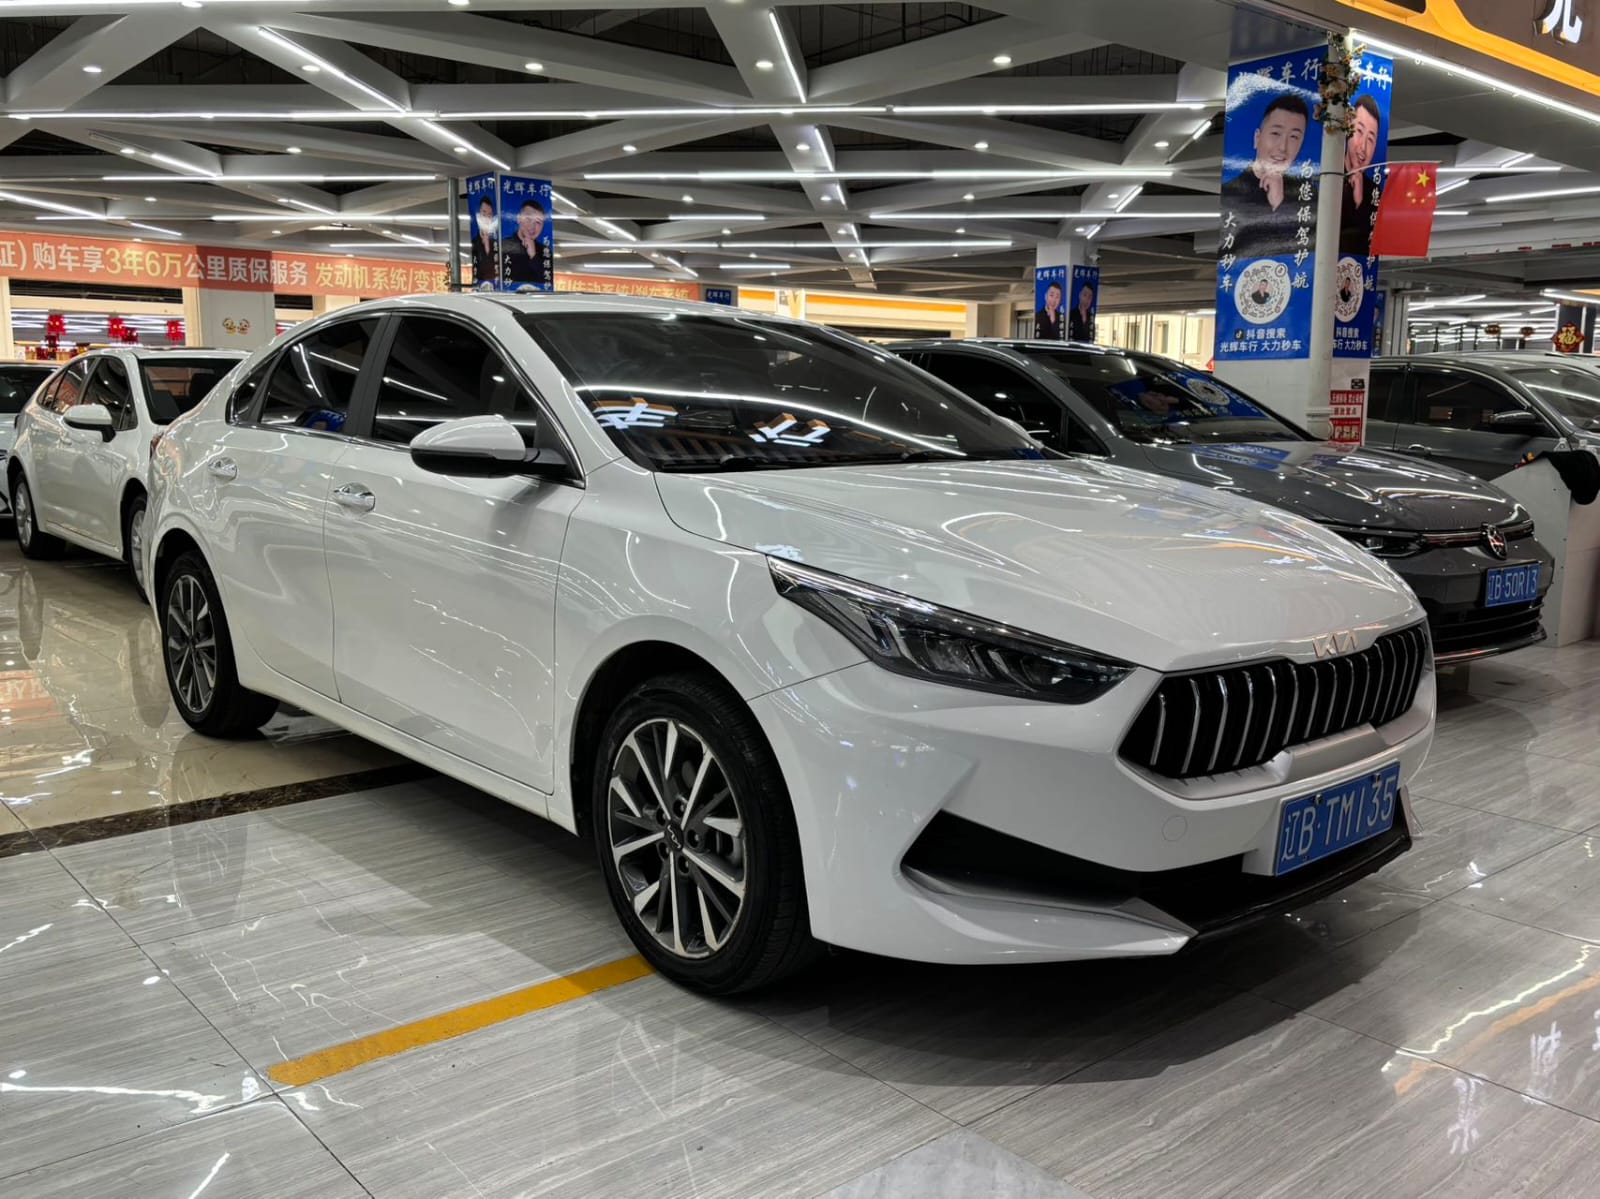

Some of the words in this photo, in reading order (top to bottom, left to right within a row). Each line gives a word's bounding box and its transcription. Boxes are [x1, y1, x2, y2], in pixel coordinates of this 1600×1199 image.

[503, 180, 553, 197] 光辉车行
[1291, 157, 1314, 289] 为您保驾护航
[1219, 211, 1237, 294] 大力秒车
[1246, 327, 1286, 340] 抖音搜索
[1219, 340, 1258, 353] 光辉车行
[1261, 339, 1302, 352] 大力秒车
